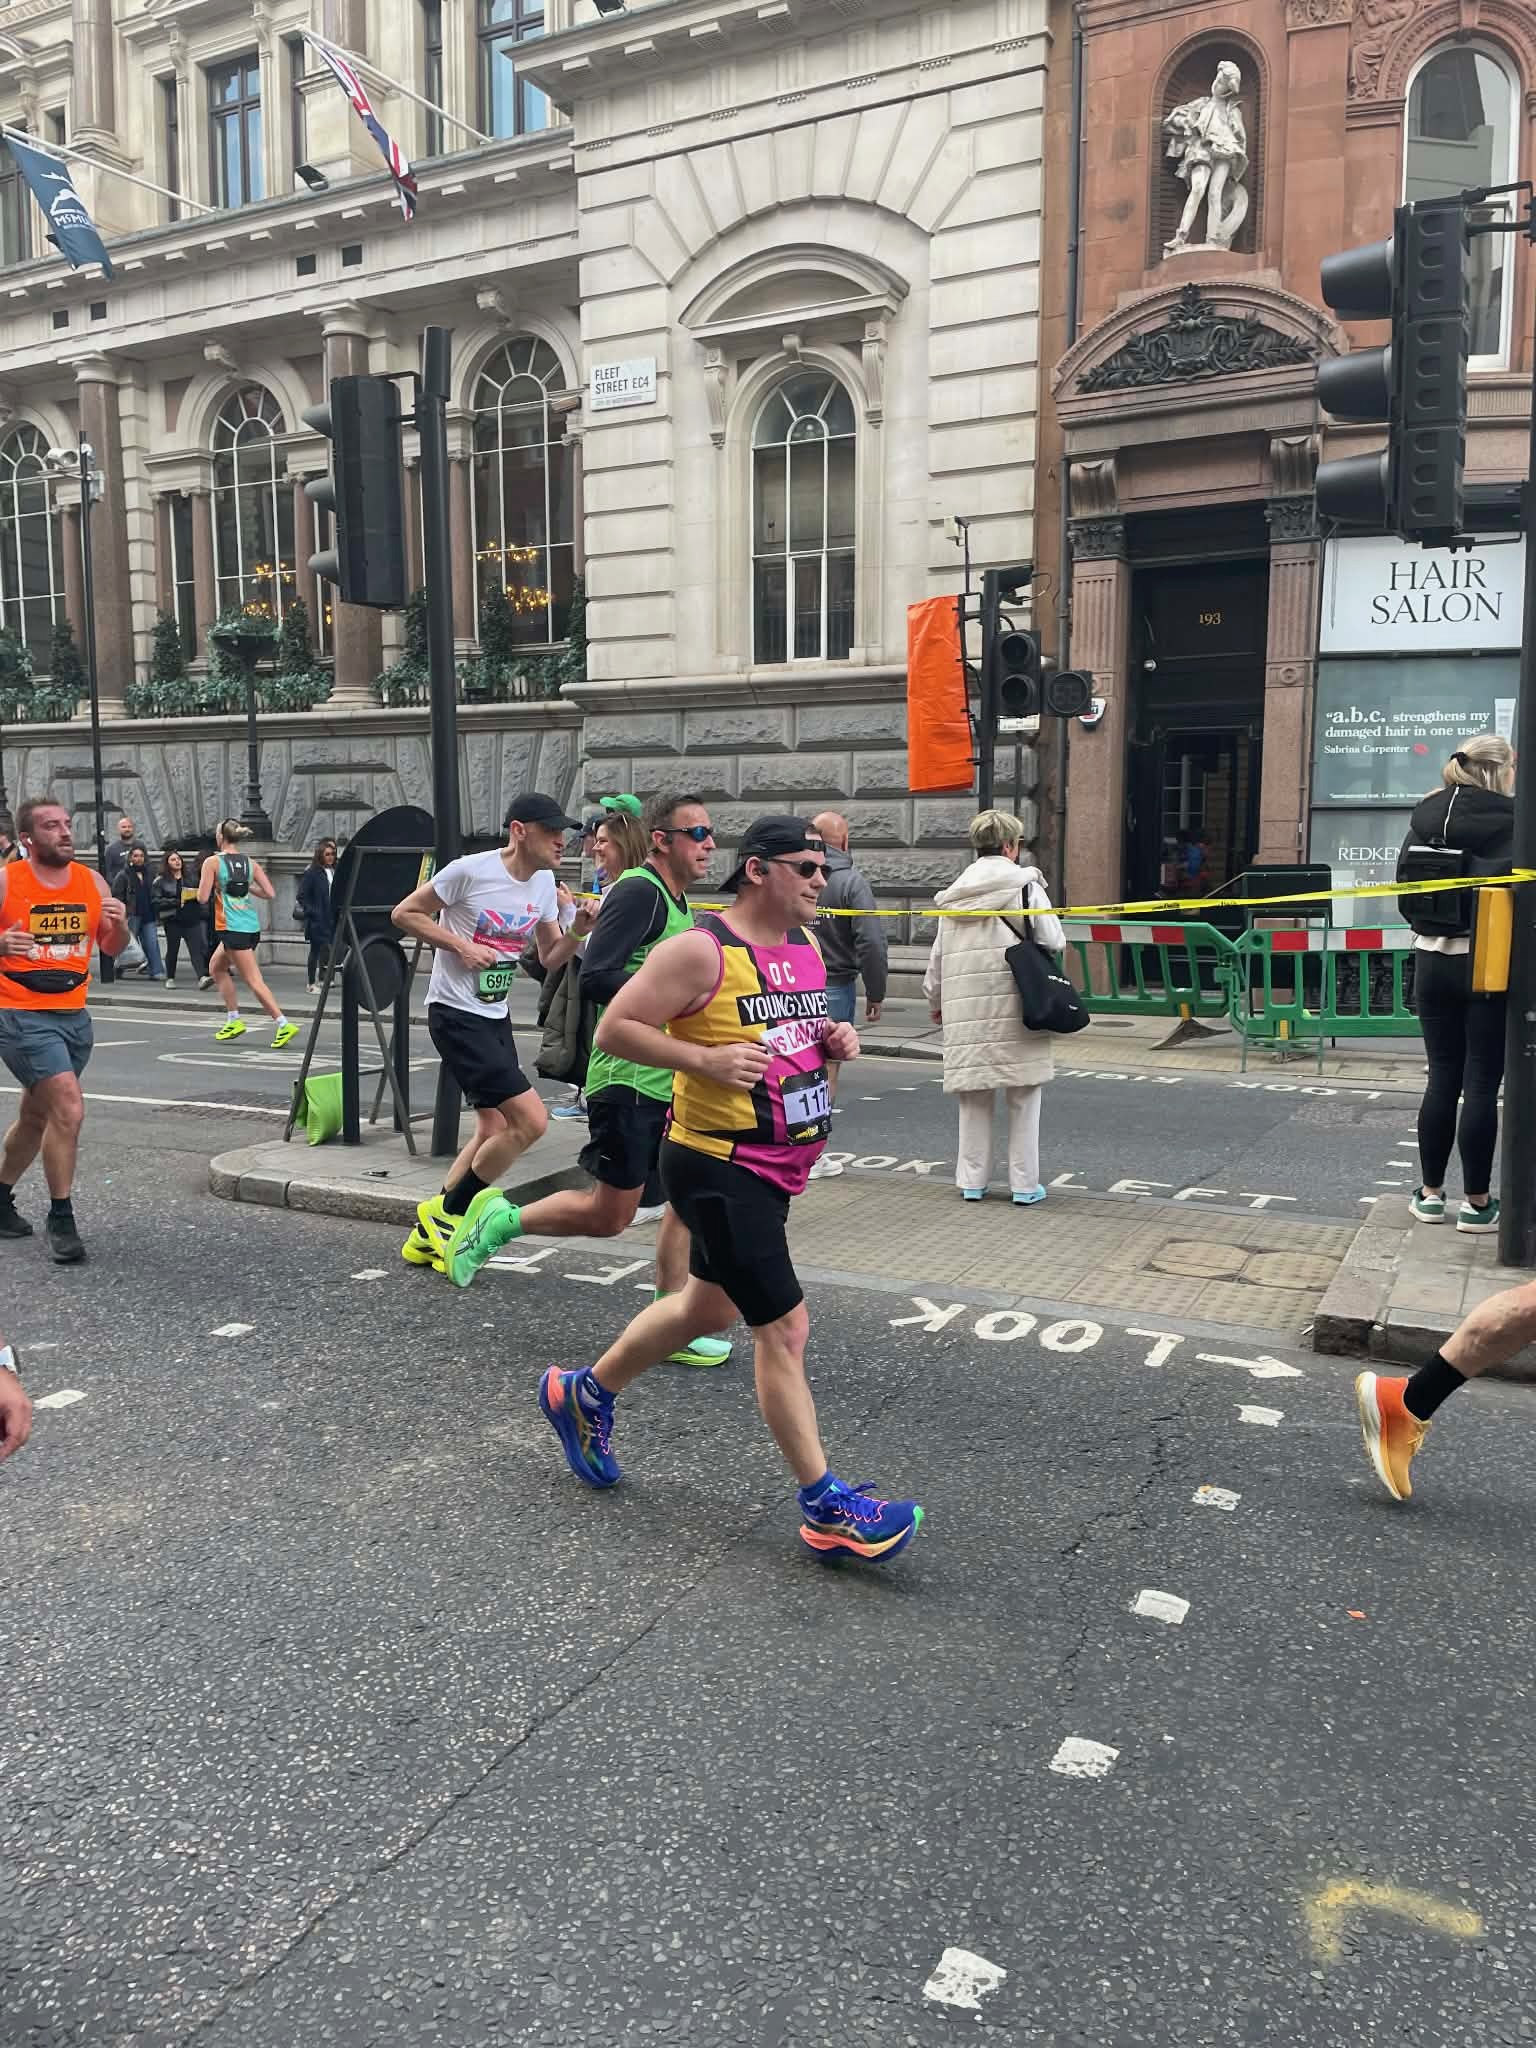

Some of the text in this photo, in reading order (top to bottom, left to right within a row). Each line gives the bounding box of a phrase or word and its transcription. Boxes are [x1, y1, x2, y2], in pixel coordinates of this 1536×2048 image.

[595, 366, 620, 382] FLEET
[595, 376, 649, 394] STREET EC4
[1389, 558, 1487, 591] HAIR
[1371, 592, 1503, 625] SALON
[1199, 612, 1221, 625] 193
[1392, 711, 1466, 724] strengthens
[1470, 712, 1490, 723] my
[1325, 726, 1381, 739] damaged
[1385, 726, 1411, 736] hair
[1414, 725, 1426, 736] in
[1430, 727, 1454, 736] one
[1324, 745, 1410, 754] Sabrina Carpenter
[40, 915, 81, 931] 4418
[486, 972, 513, 989] 6915
[742, 992, 828, 1022] YOUNG LIVES
[1048, 1172, 1297, 1209] LEFT
[889, 1296, 1185, 1367] LOOK
